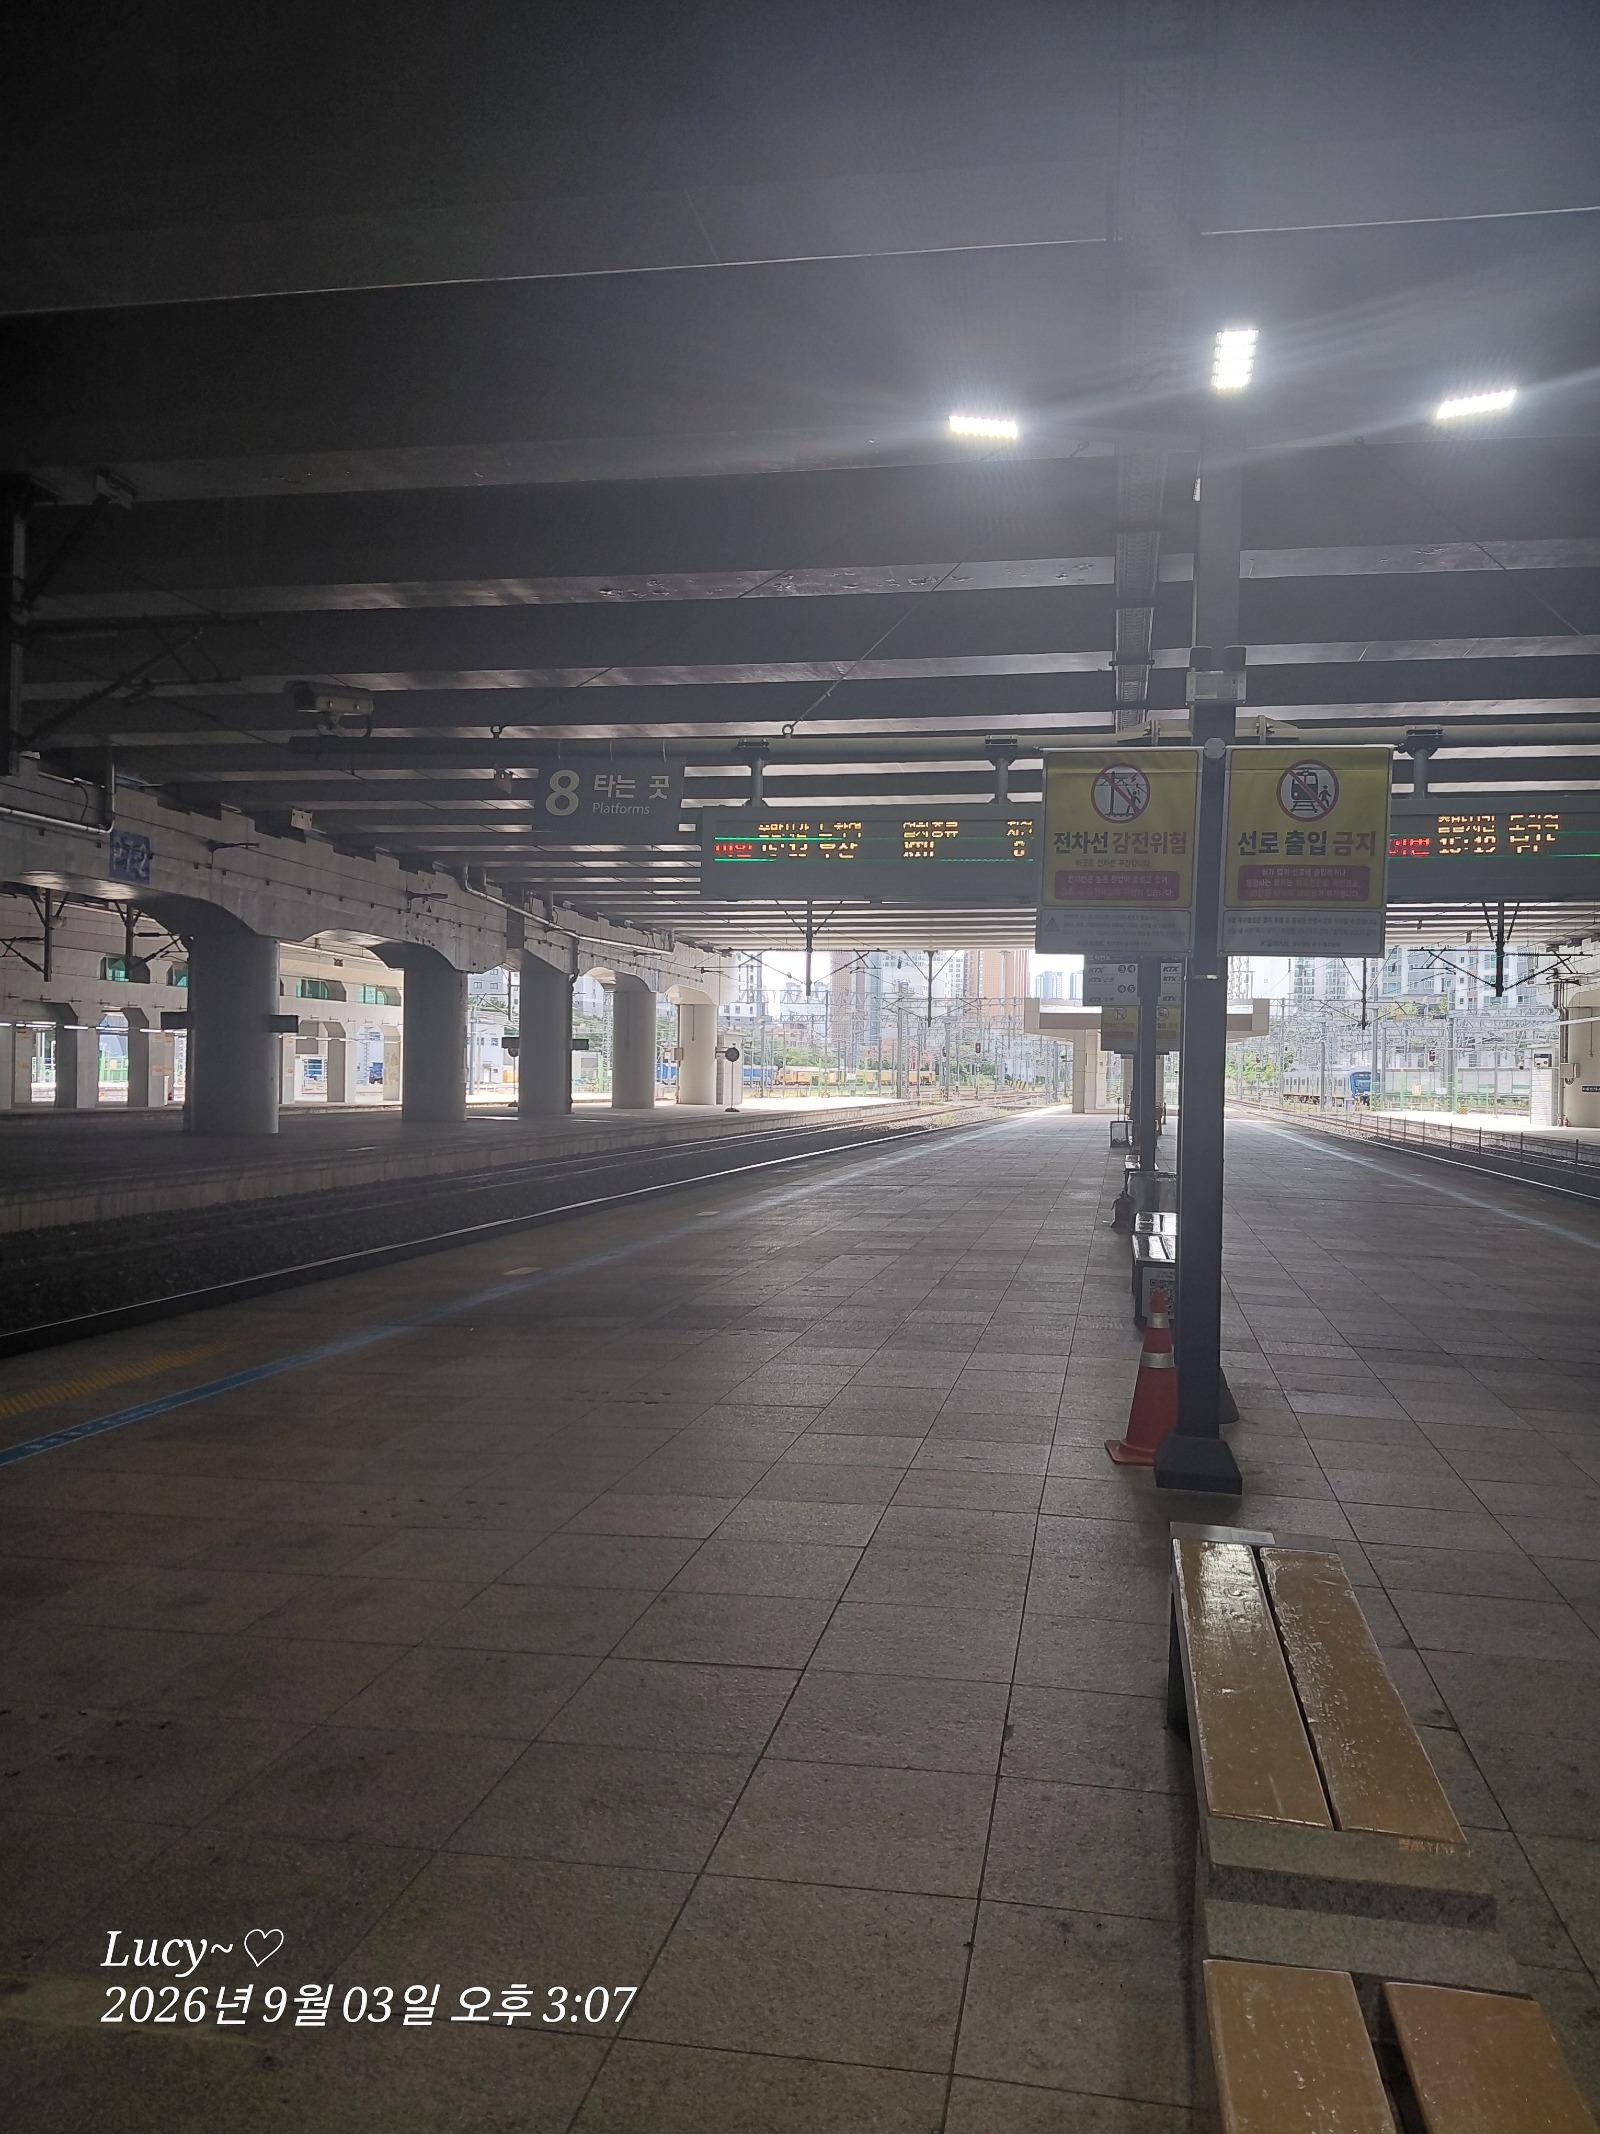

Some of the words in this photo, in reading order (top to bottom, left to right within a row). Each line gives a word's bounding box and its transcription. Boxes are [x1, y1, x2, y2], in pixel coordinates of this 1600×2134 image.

[545, 769, 580, 816] 8
[593, 774, 636, 799] 타는
[648, 775, 670, 800] 곳
[592, 802, 651, 815] Platforms
[1053, 831, 1108, 854] 전차선
[1112, 831, 1187, 855] 감전위험
[1238, 831, 1280, 856] 선로
[1285, 831, 1327, 856] 출입
[1333, 831, 1376, 857] 금지
